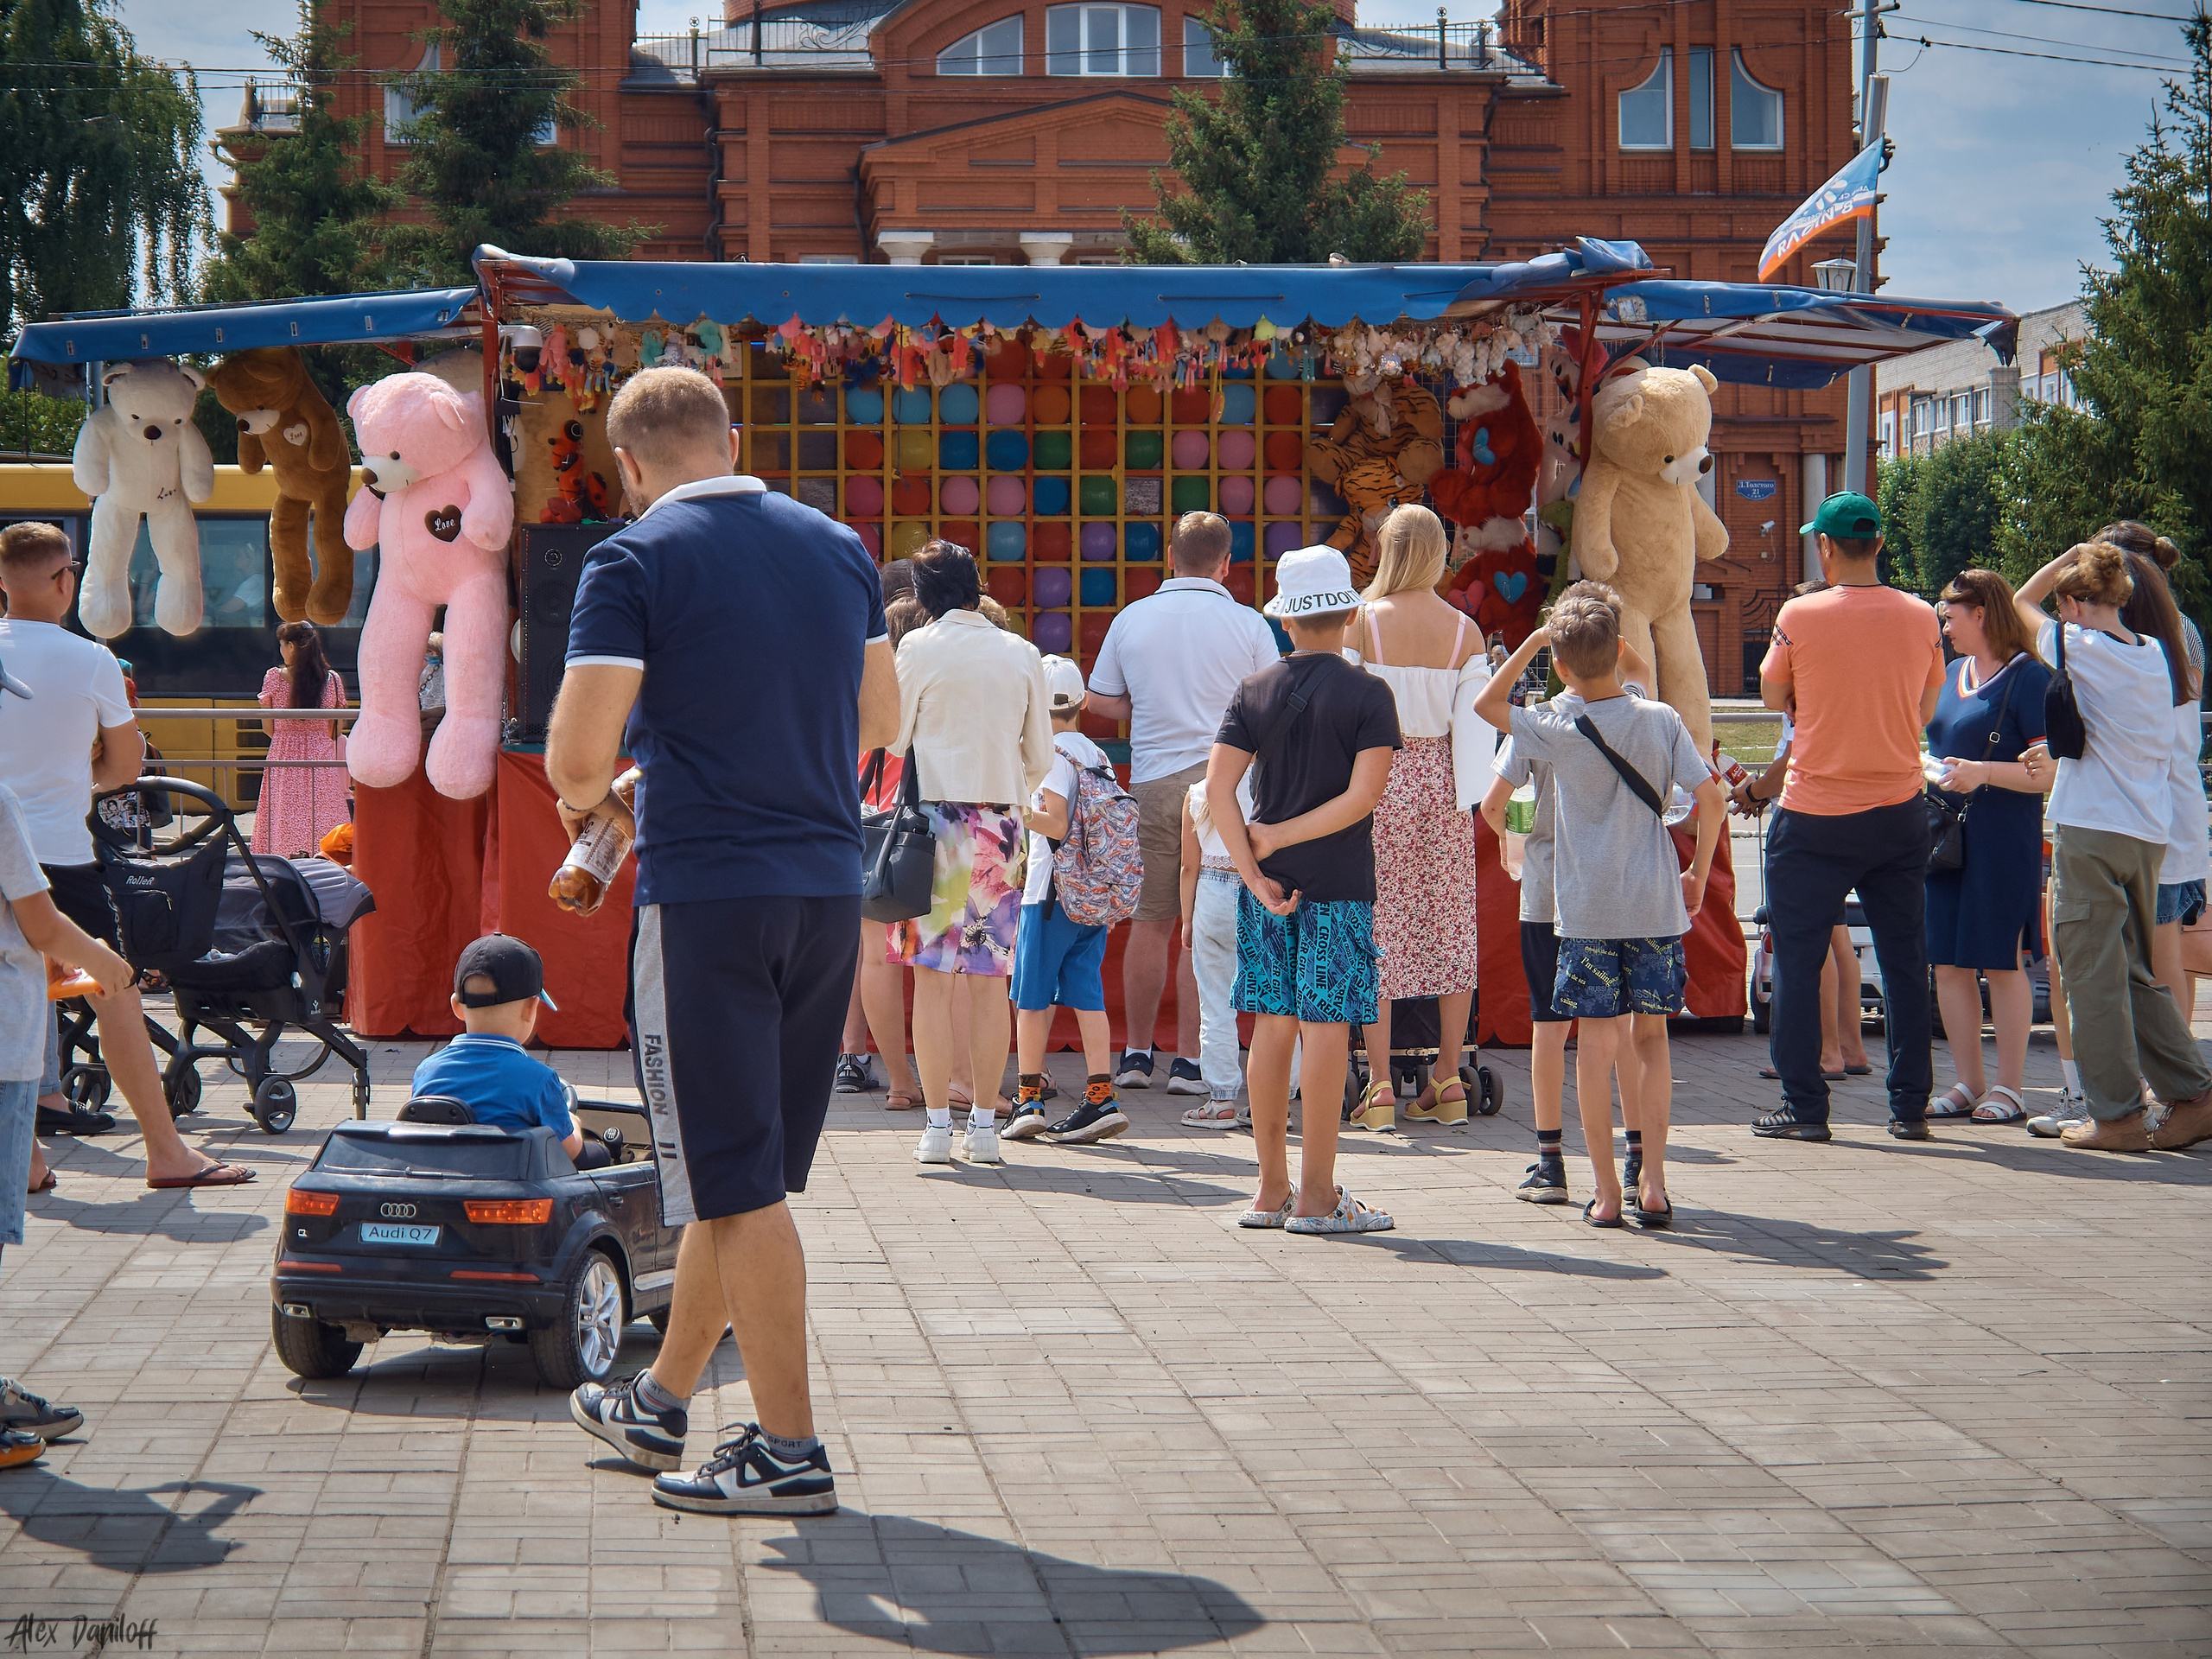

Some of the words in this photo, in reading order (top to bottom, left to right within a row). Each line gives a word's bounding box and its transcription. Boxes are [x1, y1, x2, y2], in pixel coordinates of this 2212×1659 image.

[434, 517, 455, 531] Love
[1316, 925, 1329, 962] CROSS
[1246, 971, 1257, 996] GIVE
[1315, 965, 1326, 990] LINE
[1580, 957, 1592, 969] I'm
[1592, 968, 1613, 988] sailing
[644, 1033, 669, 1116] FASHION
[368, 1226, 404, 1239] Audi
[409, 1227, 433, 1241] Q7
[767, 1436, 804, 1448] SPORT
